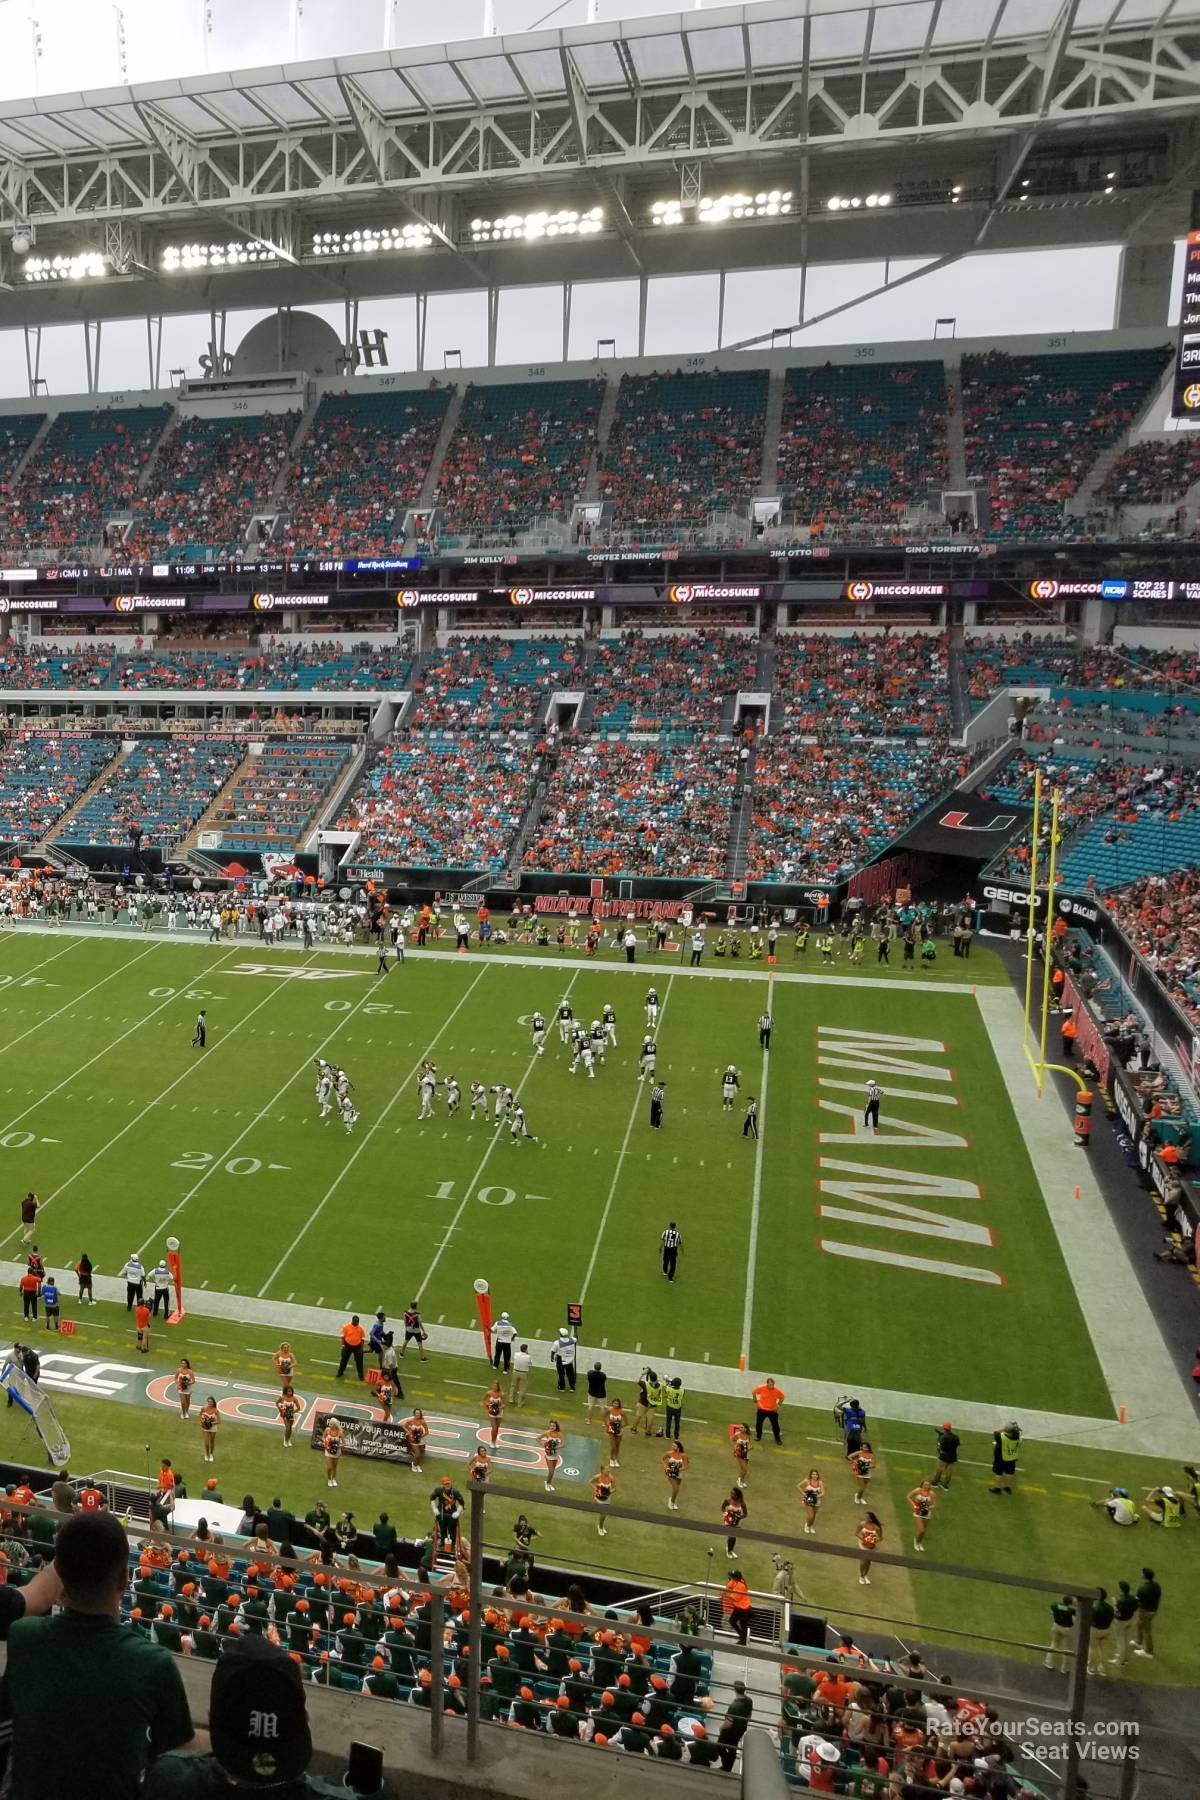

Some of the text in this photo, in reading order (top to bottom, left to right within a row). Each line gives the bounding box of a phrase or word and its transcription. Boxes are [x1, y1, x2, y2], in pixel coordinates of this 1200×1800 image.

[1047, 339, 1067, 347] 351
[855, 349, 875, 357] 350
[686, 359, 704, 367] 349
[379, 378, 395, 386] 347
[232, 402, 248, 410] 346
[479, 556, 504, 564] KELLY
[621, 552, 661, 560] KENNEDY
[357, 560, 409, 569] Hard Rock Stadium
[175, 566, 195, 574] 11:06
[874, 585, 943, 595] MICCOSUKEE
[1134, 581, 1165, 589] TOP 25
[419, 592, 478, 602] MICCOSUKEE
[534, 590, 595, 600] MICCOSUKEE
[695, 587, 760, 598] MICCOSUKEE
[1132, 590, 1166, 598] SCORES
[10, 601, 57, 609] MICCOSUKEE
[135, 599, 186, 607] MICCOSUKEE
[274, 595, 329, 605] MICCOSUKEE
[983, 886, 1041, 906] GEICO
[535, 896, 590, 914] MIAMI
[148, 987, 212, 1000] 30
[324, 1000, 395, 1014] 20
[813, 1024, 1008, 1287] MIAMI
[171, 1150, 262, 1175] 20
[427, 1180, 517, 1206] 10
[569, 1305, 580, 1318] 3
[62, 1322, 73, 1333] 20
[368, 1370, 380, 1384] 10
[362, 1426, 381, 1435] YOUR
[362, 1446, 389, 1454] INSTITUTE
[363, 1440, 381, 1448] SPORTS
[383, 1443, 407, 1452] MEDICINE
[87, 1495, 94, 1506] 8
